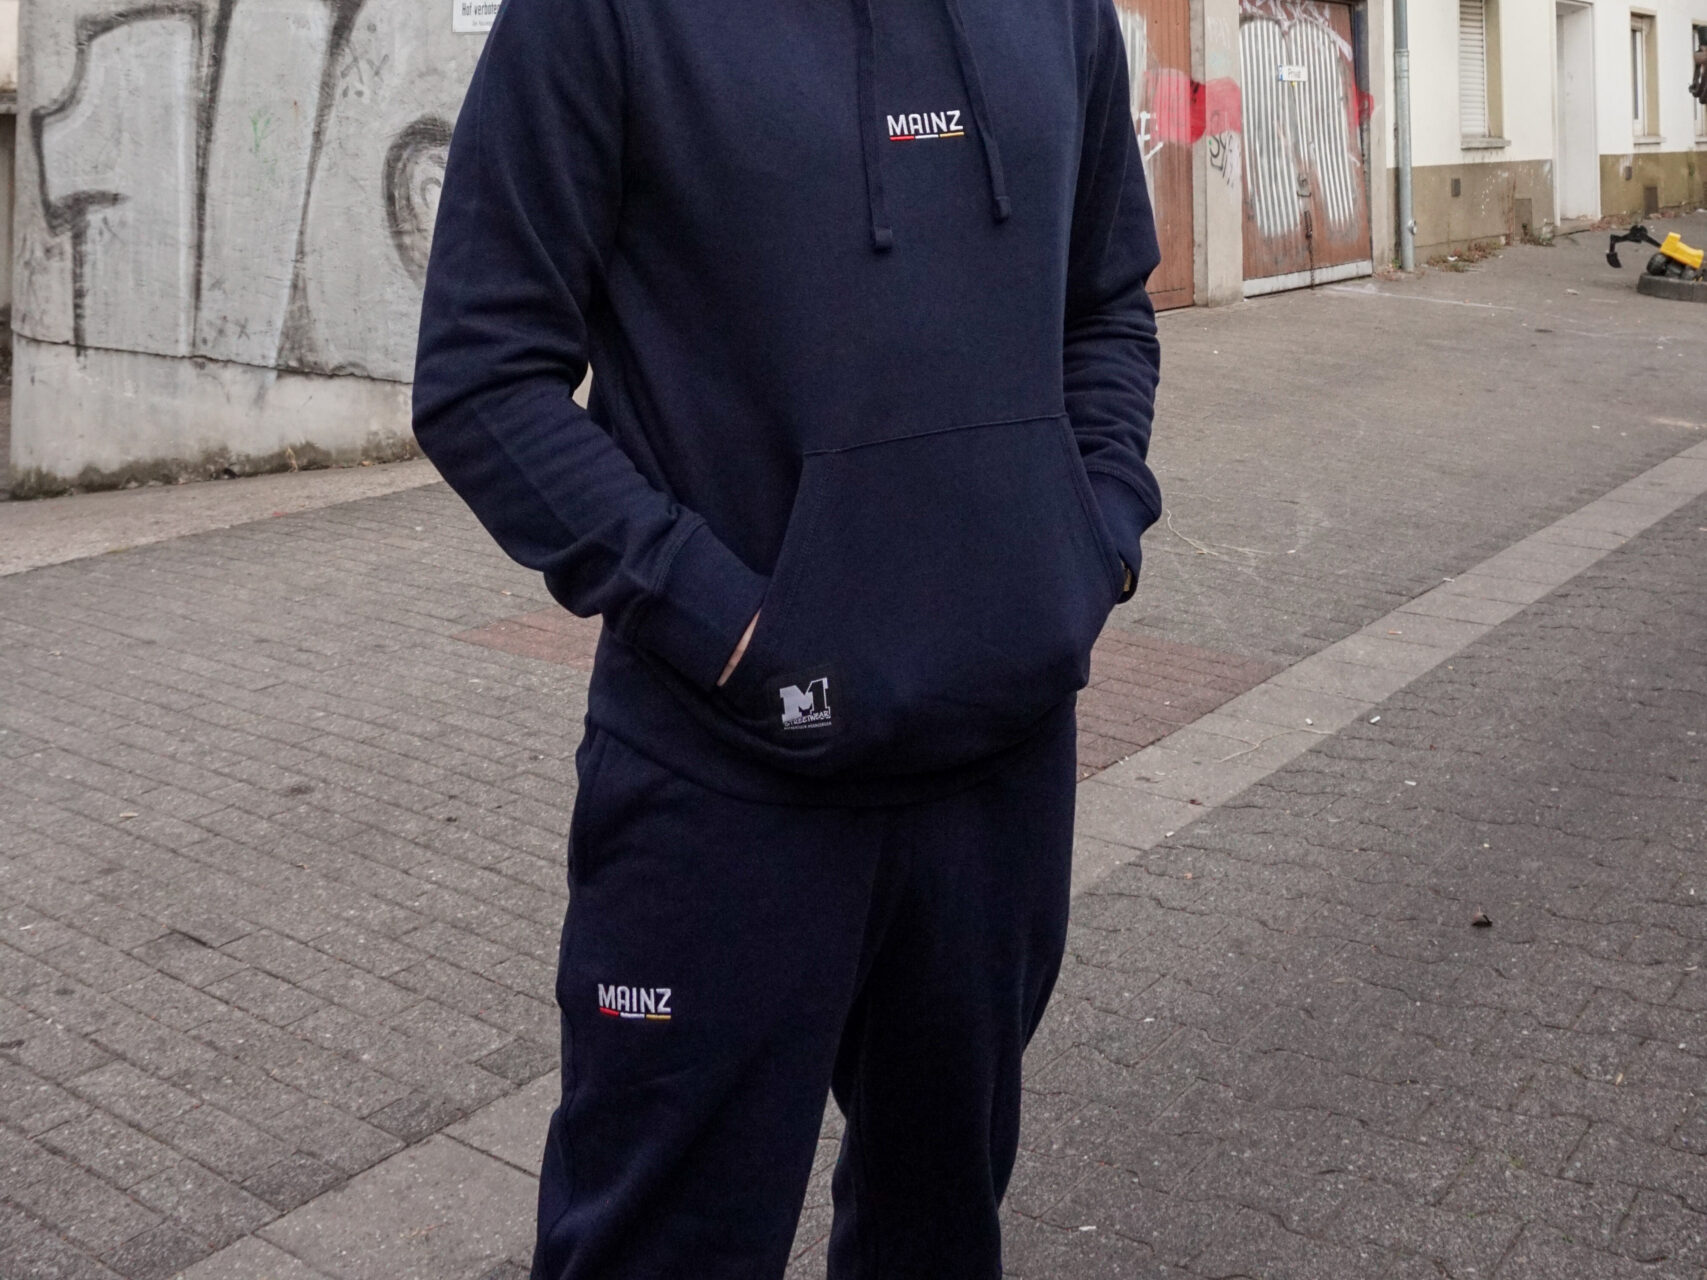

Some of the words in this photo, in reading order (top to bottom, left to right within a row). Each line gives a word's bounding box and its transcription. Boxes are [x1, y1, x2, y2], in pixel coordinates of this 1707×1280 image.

[462, 2, 472, 16] Hof
[886, 110, 964, 136] MAINZ
[598, 984, 672, 1013] MAINZ
